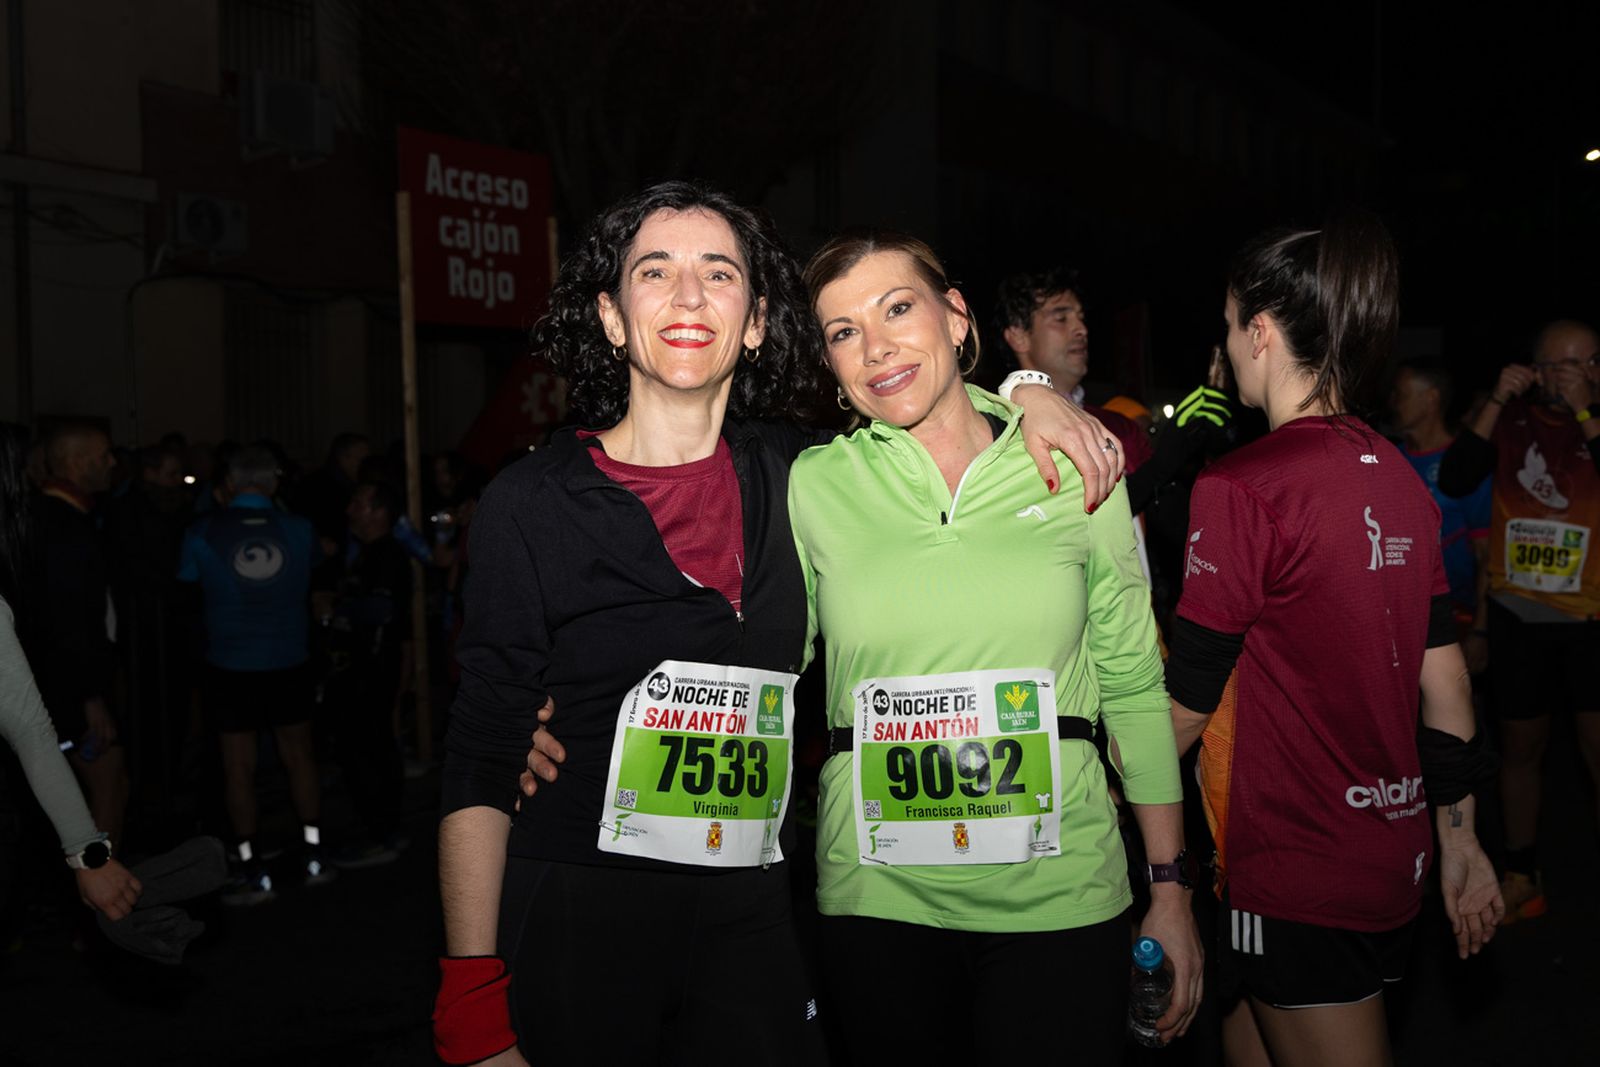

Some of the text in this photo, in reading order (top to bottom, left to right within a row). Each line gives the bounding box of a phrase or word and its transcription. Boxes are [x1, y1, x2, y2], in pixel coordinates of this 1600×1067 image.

[425, 152, 529, 210] Acceso
[438, 206, 520, 260] cajón
[447, 254, 515, 310] Rojo
[648, 677, 669, 693] 43
[674, 677, 696, 685] CARRERA
[697, 678, 717, 687] URBANA
[911, 689, 933, 697] URBANA
[672, 685, 750, 708] NOCHE DE
[873, 693, 889, 709] 43
[893, 693, 977, 716] NOCHE DE
[643, 706, 747, 734] SAN ANTÓN
[873, 713, 979, 741] SAN ANTÓN
[656, 735, 769, 798] 7533
[886, 738, 1026, 801] 9092
[693, 801, 739, 818] Virginia
[905, 801, 1012, 818] Francisca Raquel
